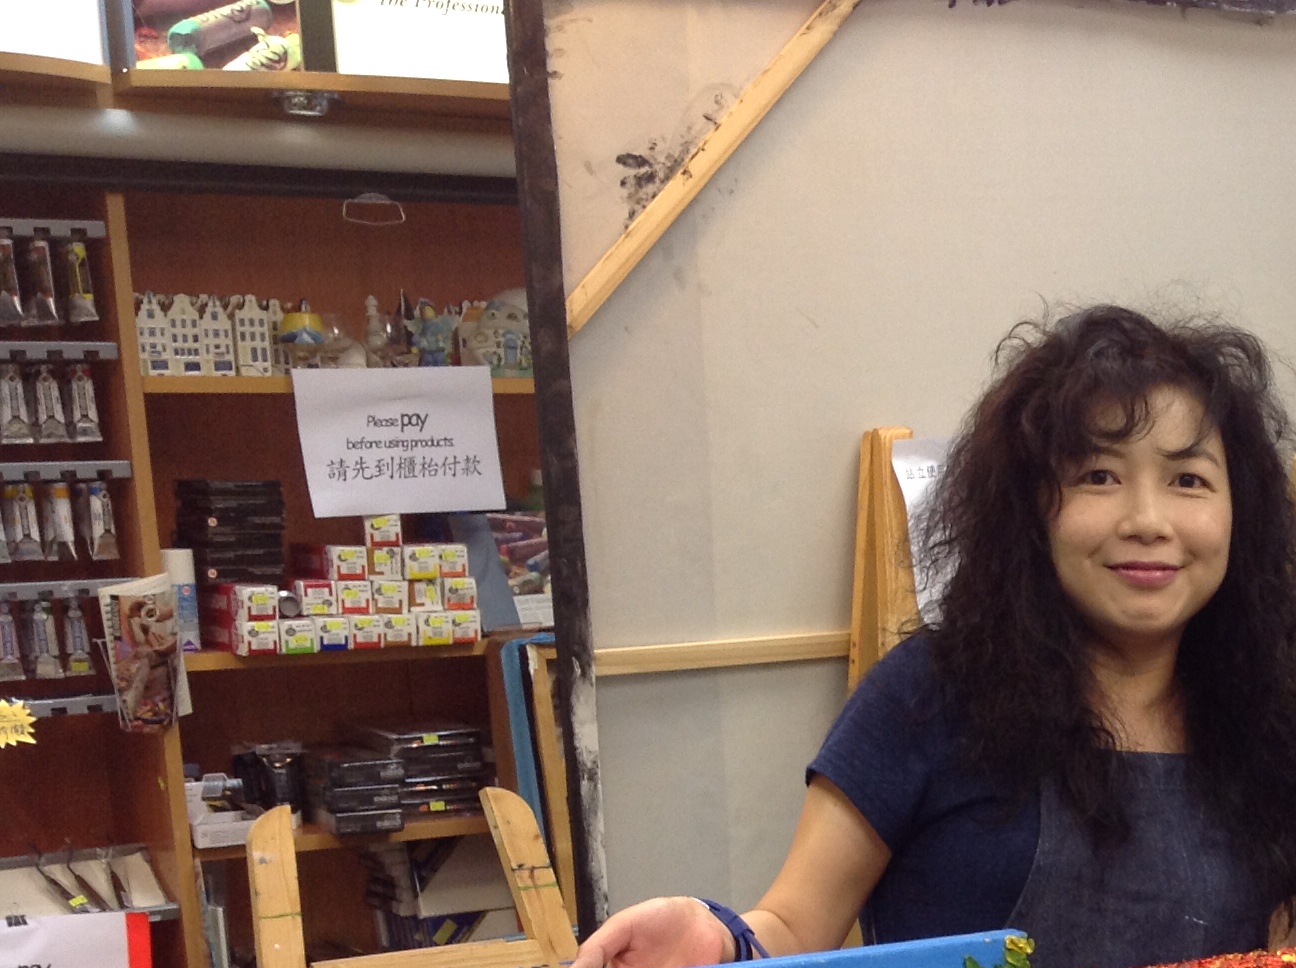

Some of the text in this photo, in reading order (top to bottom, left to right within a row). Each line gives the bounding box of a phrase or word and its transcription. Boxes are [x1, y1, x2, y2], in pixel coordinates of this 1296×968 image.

[366, 413, 429, 433] Please pay
[346, 436, 383, 450] before
[383, 436, 410, 452] using
